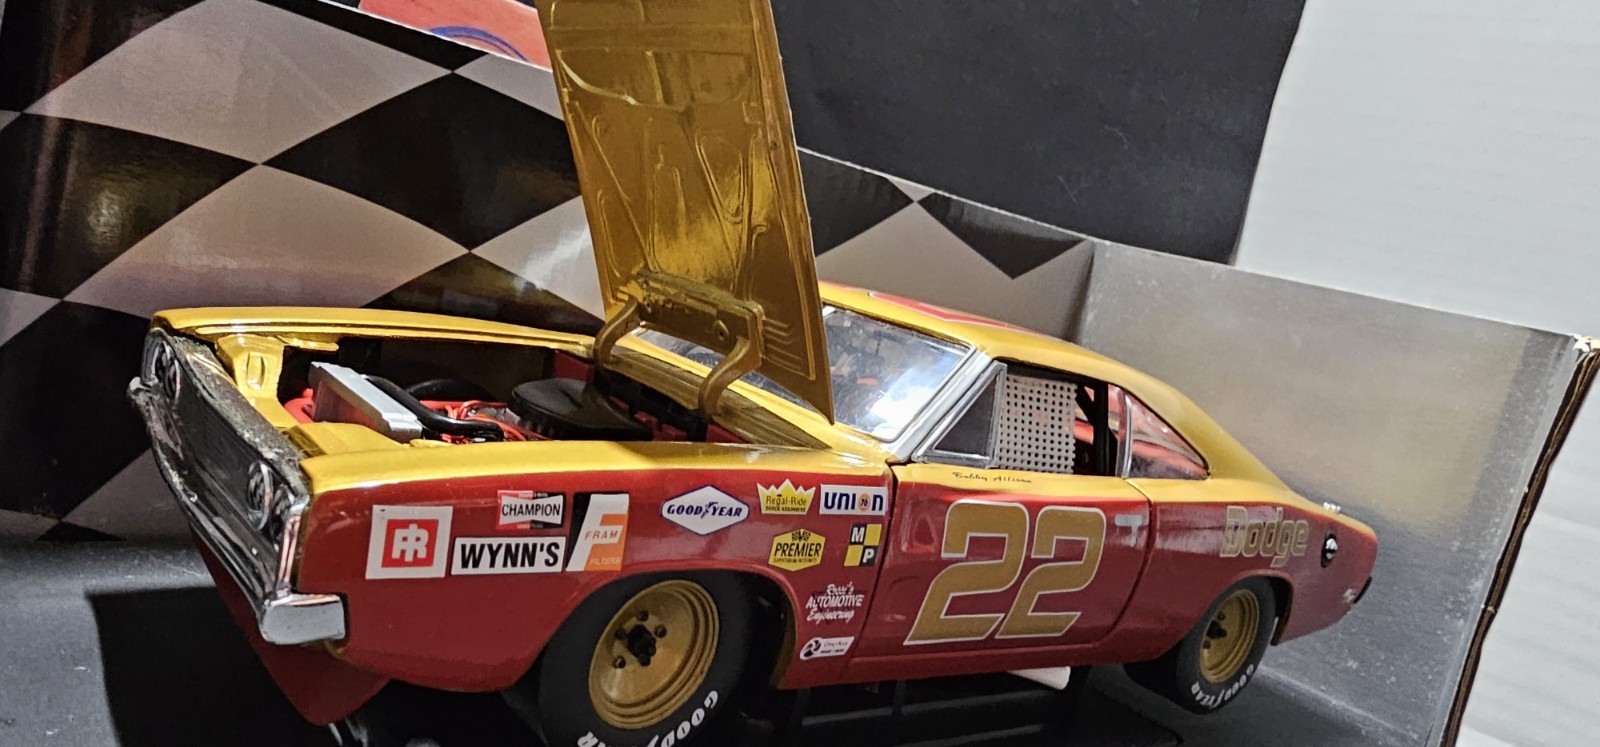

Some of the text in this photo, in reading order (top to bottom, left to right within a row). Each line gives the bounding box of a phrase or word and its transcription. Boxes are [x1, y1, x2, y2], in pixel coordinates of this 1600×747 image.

[766, 494, 807, 506] Regal-Ride
[502, 503, 561, 517] CHAMPION
[667, 502, 742, 519] GOODYEAR
[585, 530, 619, 541] FRAM
[1220, 505, 1309, 568] Dodge
[460, 541, 560, 569] WYNN'S
[773, 542, 822, 558] PREMIER
[589, 556, 622, 566] FILTERS
[903, 498, 1107, 646] 22
[805, 594, 865, 609] AUTOMOTIVE
[806, 608, 855, 625] Engineering
